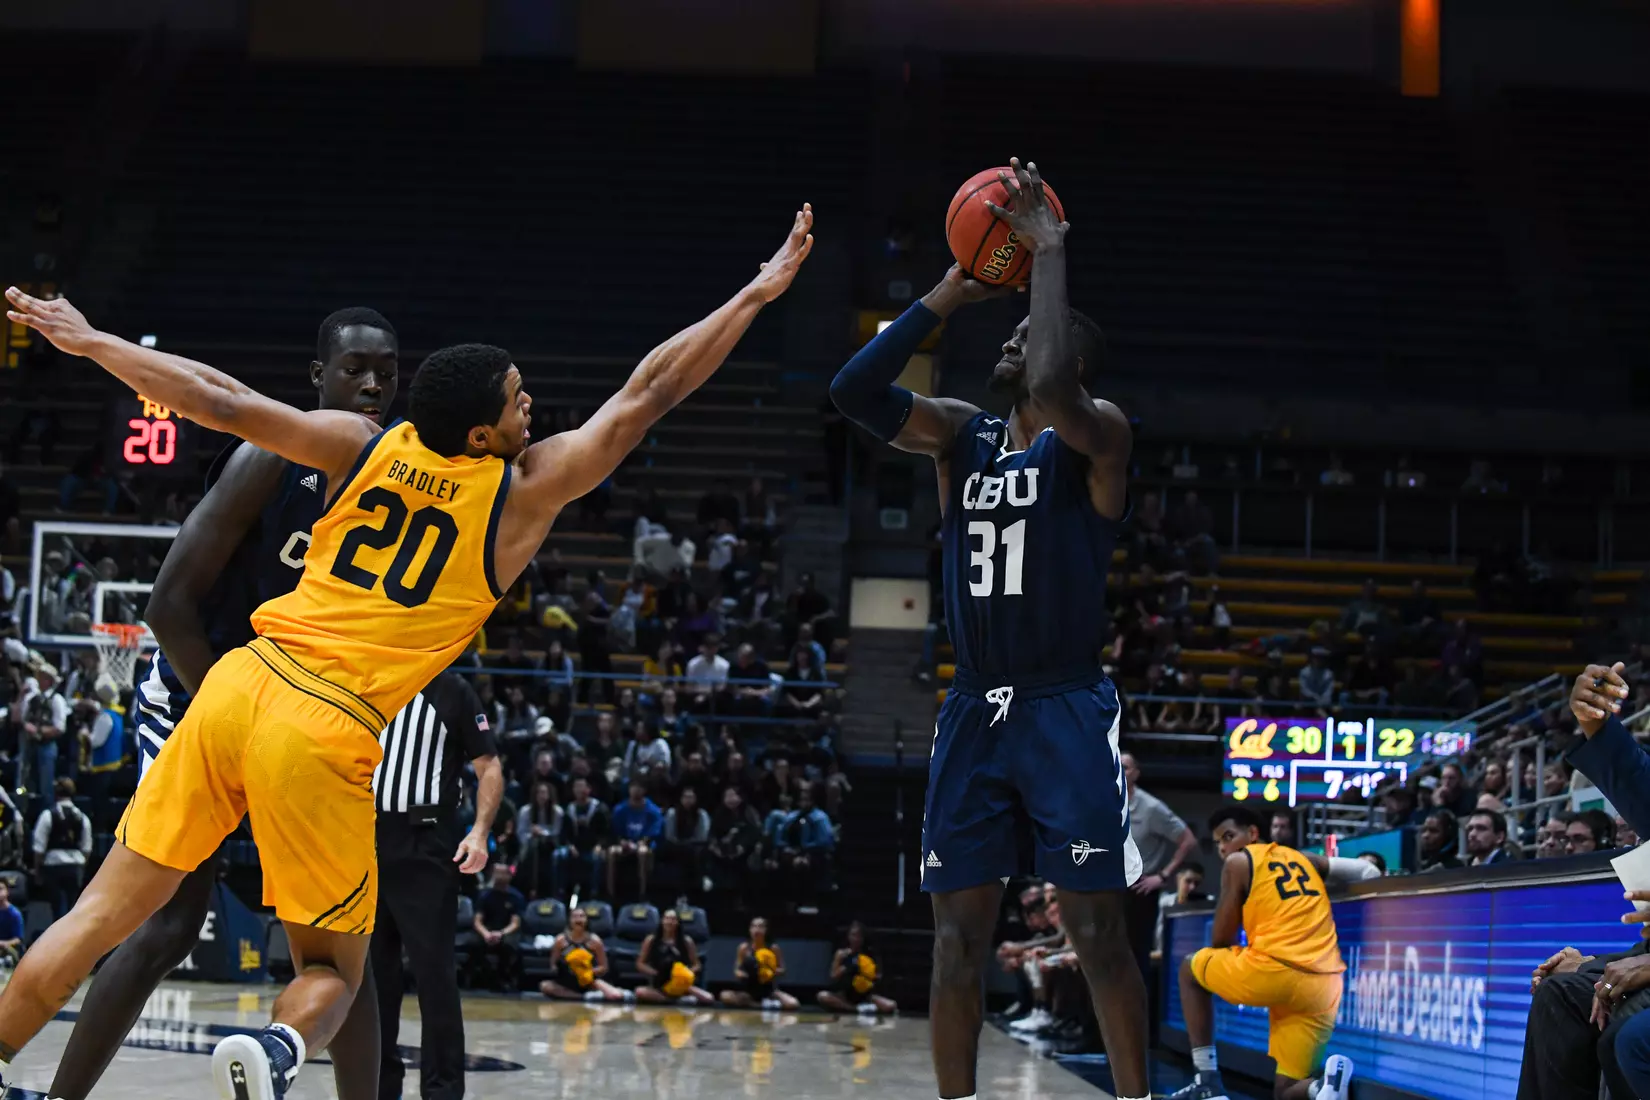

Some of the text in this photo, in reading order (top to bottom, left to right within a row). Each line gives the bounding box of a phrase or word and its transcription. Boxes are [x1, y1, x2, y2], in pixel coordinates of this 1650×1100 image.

[979, 231, 1019, 280] Wilso
[124, 418, 176, 464] 20
[388, 460, 460, 502] BRADLEY
[962, 467, 1039, 511] CBU
[330, 486, 459, 608] 20
[967, 519, 1026, 597] 31
[1228, 719, 1278, 759] Cal
[1286, 726, 1322, 754] 30
[1342, 735, 1356, 760] 1
[1378, 728, 1415, 756] 22
[1233, 778, 1280, 801] 3 6
[1268, 861, 1321, 900] 22
[1349, 940, 1485, 1050] Honda Dealers
